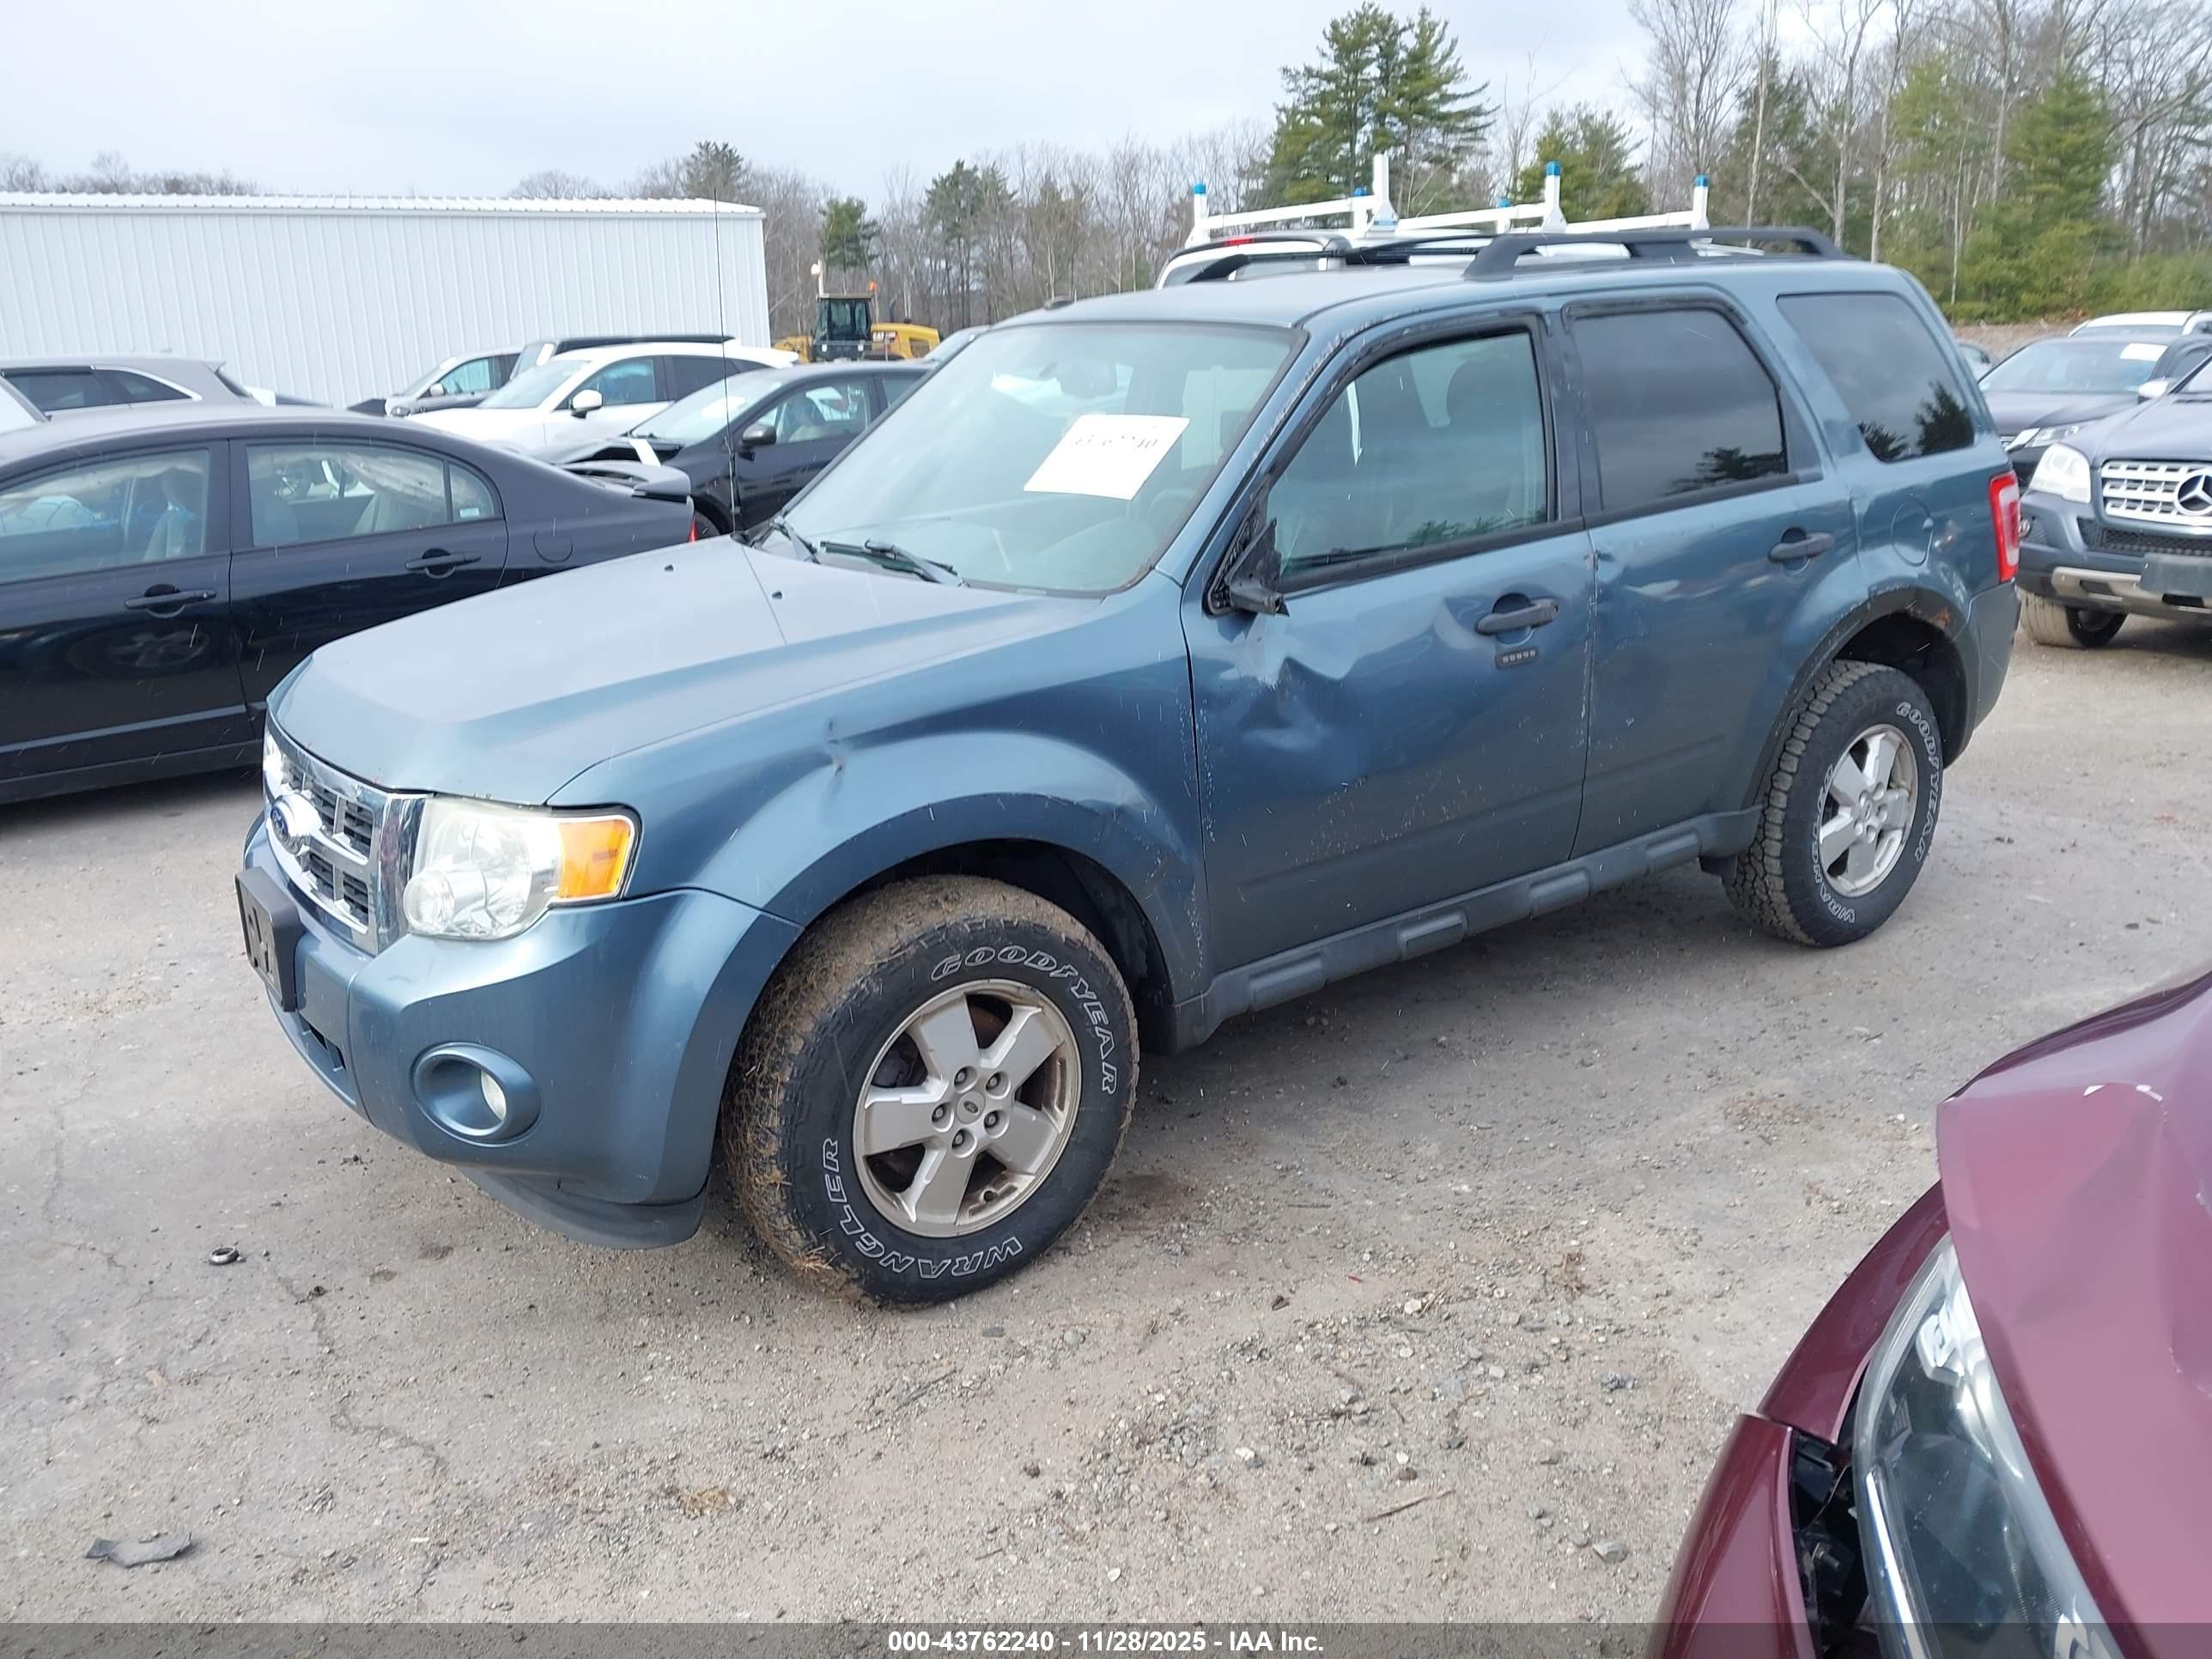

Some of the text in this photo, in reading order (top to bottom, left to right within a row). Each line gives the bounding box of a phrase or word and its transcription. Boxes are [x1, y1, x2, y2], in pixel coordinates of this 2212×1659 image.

[1896, 702, 1940, 862] GOODYEAR
[931, 945, 1117, 1095] GOODYEAR
[823, 1138, 1024, 1279] WRANGLER
